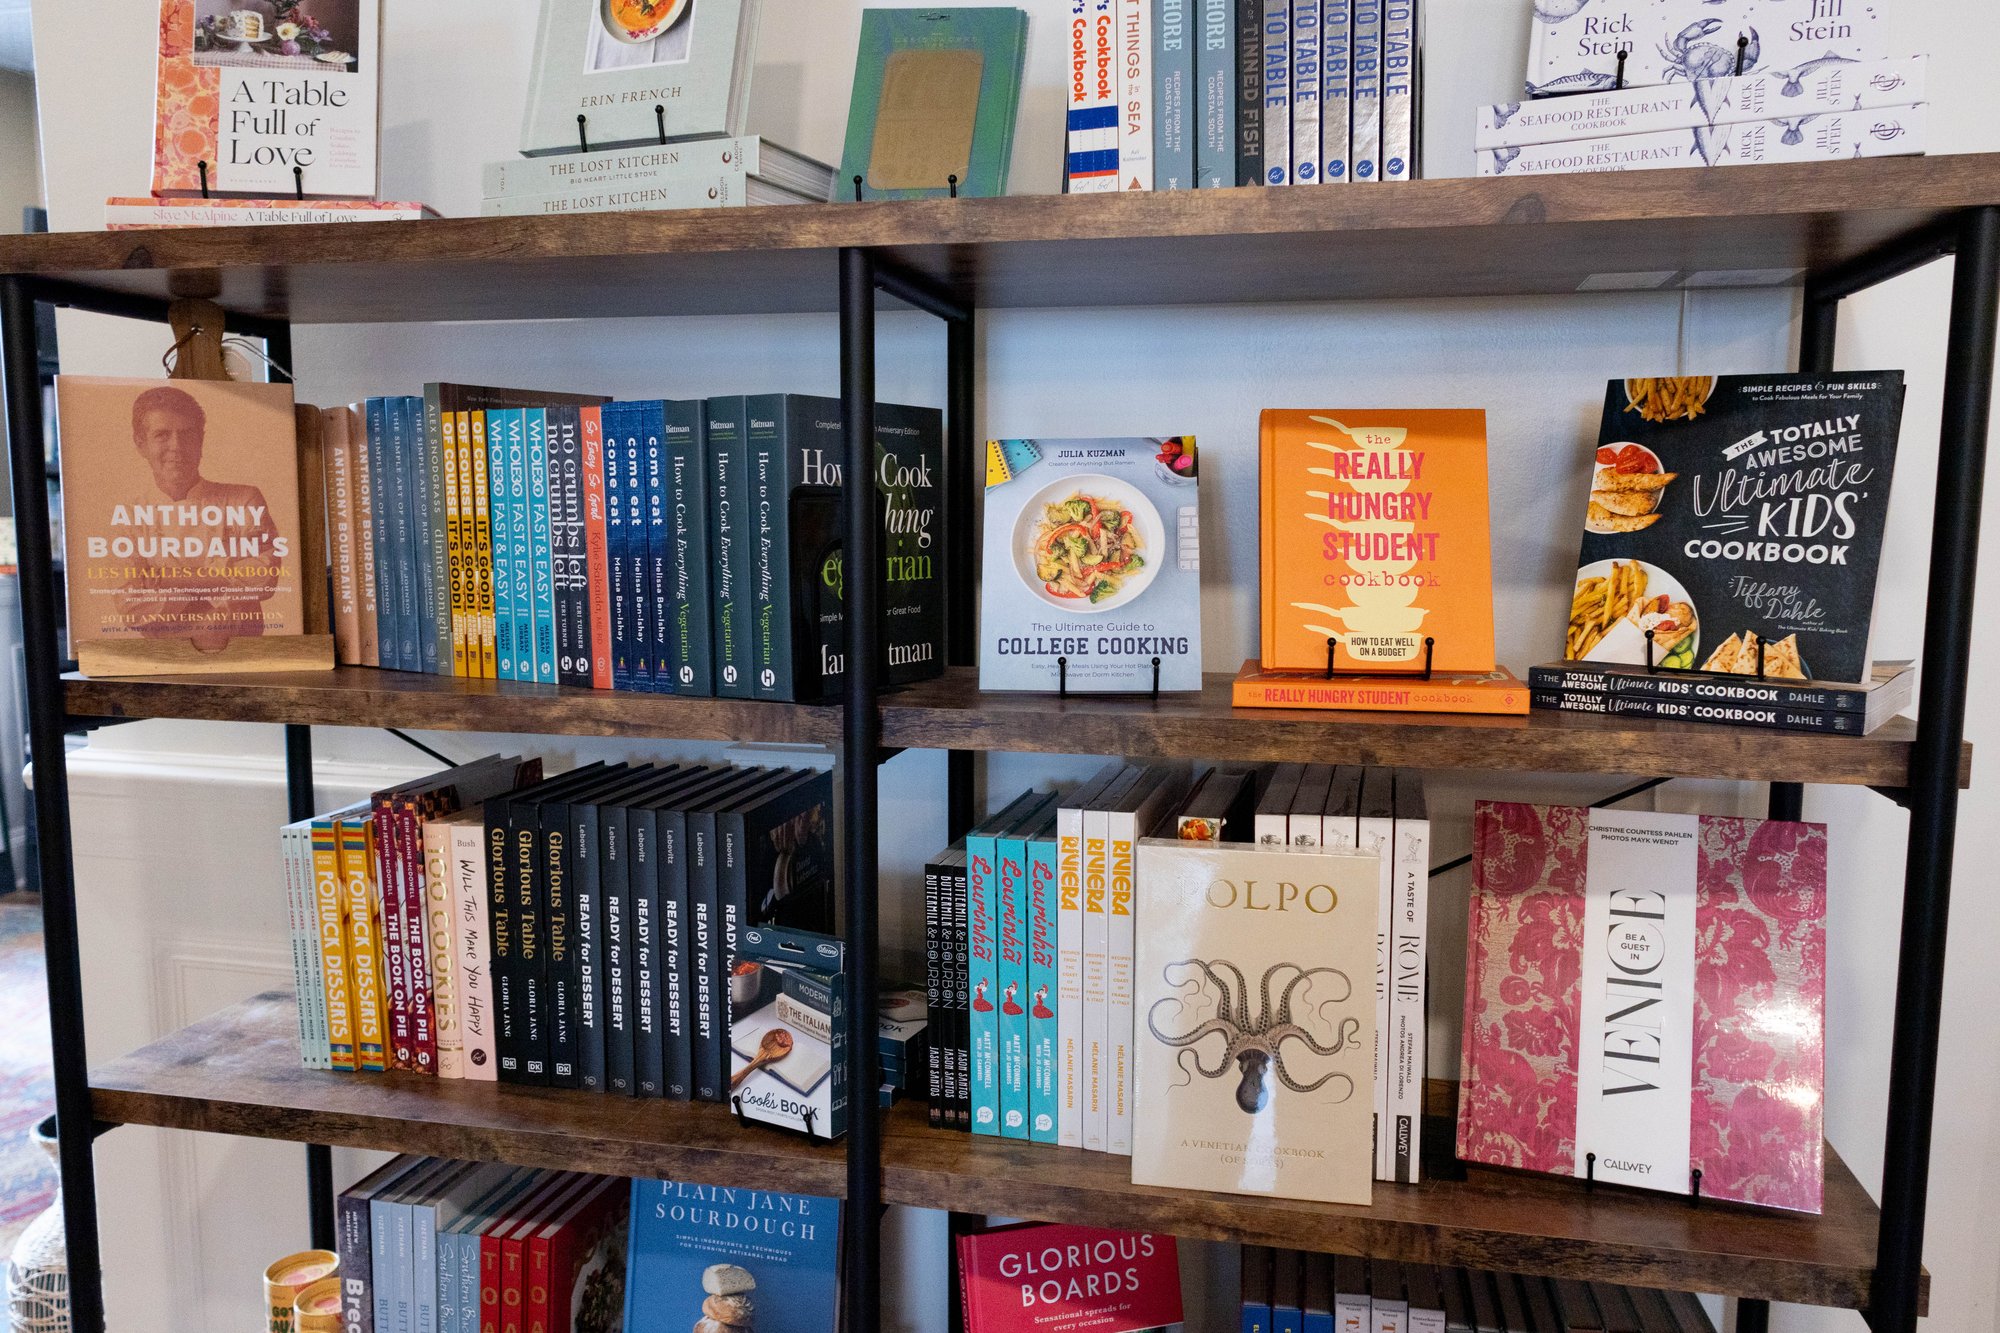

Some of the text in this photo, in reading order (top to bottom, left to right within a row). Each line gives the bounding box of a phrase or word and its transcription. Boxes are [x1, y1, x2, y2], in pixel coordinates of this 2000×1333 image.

[1584, 13, 1634, 34] Rick
[1806, 0, 1842, 22] Jill
[1126, 12, 1140, 79] THINGS
[1790, 21, 1851, 42] Stein
[1097, 15, 1111, 100] Cookbook
[1578, 37, 1634, 56] Stein
[1266, 41, 1287, 108] TABLE
[1296, 35, 1317, 103] TABLE
[231, 80, 349, 107] A Table
[580, 87, 682, 108] ERIN FRENCH
[1243, 23, 1258, 157] TINNED FISH
[1590, 98, 1610, 106] THE
[231, 109, 320, 137] Full of
[1128, 101, 1141, 135] SEA
[1520, 99, 1681, 126] SEAFOOD RESTAURANT
[1571, 118, 1626, 131] COOKBOOK
[230, 139, 316, 166] Love
[550, 152, 680, 176] THE LOST KITCHEN
[1742, 385, 1772, 393] SIMPLE
[1776, 384, 1812, 392] RECIPES
[1847, 382, 1876, 390] SKILLS
[1366, 434, 1391, 444] the
[1734, 414, 1860, 452] THE TOTALLY
[1746, 434, 1863, 469] AWESOME
[585, 420, 602, 520] So Easy So Good
[1334, 452, 1424, 480] REALLY
[649, 436, 663, 526] come eat
[1694, 458, 1874, 516] Ultimate
[111, 504, 266, 526] ANTHONY
[473, 421, 490, 610] OF COURSE IT'S GOOD!
[562, 424, 587, 592] no crumbs left
[1328, 492, 1432, 520] HUNGRY
[1758, 491, 1868, 539] KIDS'
[428, 404, 448, 641] ALEX SNODGRASS dinner tonight
[758, 452, 772, 601] How to Cook Everything
[87, 534, 289, 558] BOURDAIN'S
[534, 504, 549, 602] FAST & EASY
[1323, 533, 1440, 561] STUDENT
[1684, 540, 1849, 565] COOKBOOK
[87, 566, 291, 579] LES HALLES COOKBOOK
[1324, 571, 1440, 587] cookbook
[655, 557, 665, 644] Melissa Ben-Ishay
[1734, 576, 1800, 608] Tiffany
[100, 611, 283, 624] 20TH ANNIVERSARY EDITION
[1763, 598, 1826, 620] Dahle
[760, 604, 773, 665] Vegetarian
[1031, 622, 1155, 632] The Ultimate Guide to
[998, 637, 1188, 655] COLLEGE COOKING
[1351, 638, 1414, 647] HOW TO EAT WELL
[1360, 648, 1406, 656] ON A BUDGET
[1658, 682, 1824, 704] KIDS' COOKBOOK DAHLE
[457, 839, 476, 847] Bush
[1589, 825, 1692, 839] CHRISTINE COUNTESS PAHLEN
[1601, 834, 1629, 842] PHOTOS
[1652, 838, 1679, 846] WENDT
[1087, 838, 1105, 912] RIVIERA
[460, 859, 477, 922] WILL THIS
[549, 832, 564, 961] Glorious Table
[1177, 874, 1338, 914] POLPO
[972, 855, 992, 963] Lourinhã
[1406, 910, 1414, 923] OF
[428, 846, 456, 1033] 100 COOKIES
[955, 876, 967, 1010] BUTTERMILK & BOURBON
[1620, 942, 1650, 952] GUEST
[1640, 934, 1646, 942] A
[318, 871, 347, 1038] POTLUCK DESSERTS
[1397, 934, 1420, 1003] ROME
[1630, 952, 1640, 960] IN
[409, 917, 428, 1041] THE BOOK ON PIE
[697, 903, 710, 1039] READY for DESSERT
[1602, 888, 1665, 1101] VENICE
[558, 1021, 566, 1043] JANG
[789, 1007, 802, 1021] THE
[802, 1013, 831, 1033] ITALIAN
[740, 1087, 778, 1109] Cook's
[781, 1099, 818, 1120] BOOK
[1398, 1117, 1411, 1156] CALLWEY
[1604, 1158, 1652, 1174] CALLWEY
[662, 1180, 810, 1216] PLAIN JANE
[656, 1203, 815, 1240] SOURDOUGH
[1000, 1234, 1154, 1278] GLORIOUS
[1022, 1268, 1139, 1307] BOARDS
[1034, 1303, 1131, 1324] Sensational spreads for
[1053, 1315, 1114, 1332] every occasion
